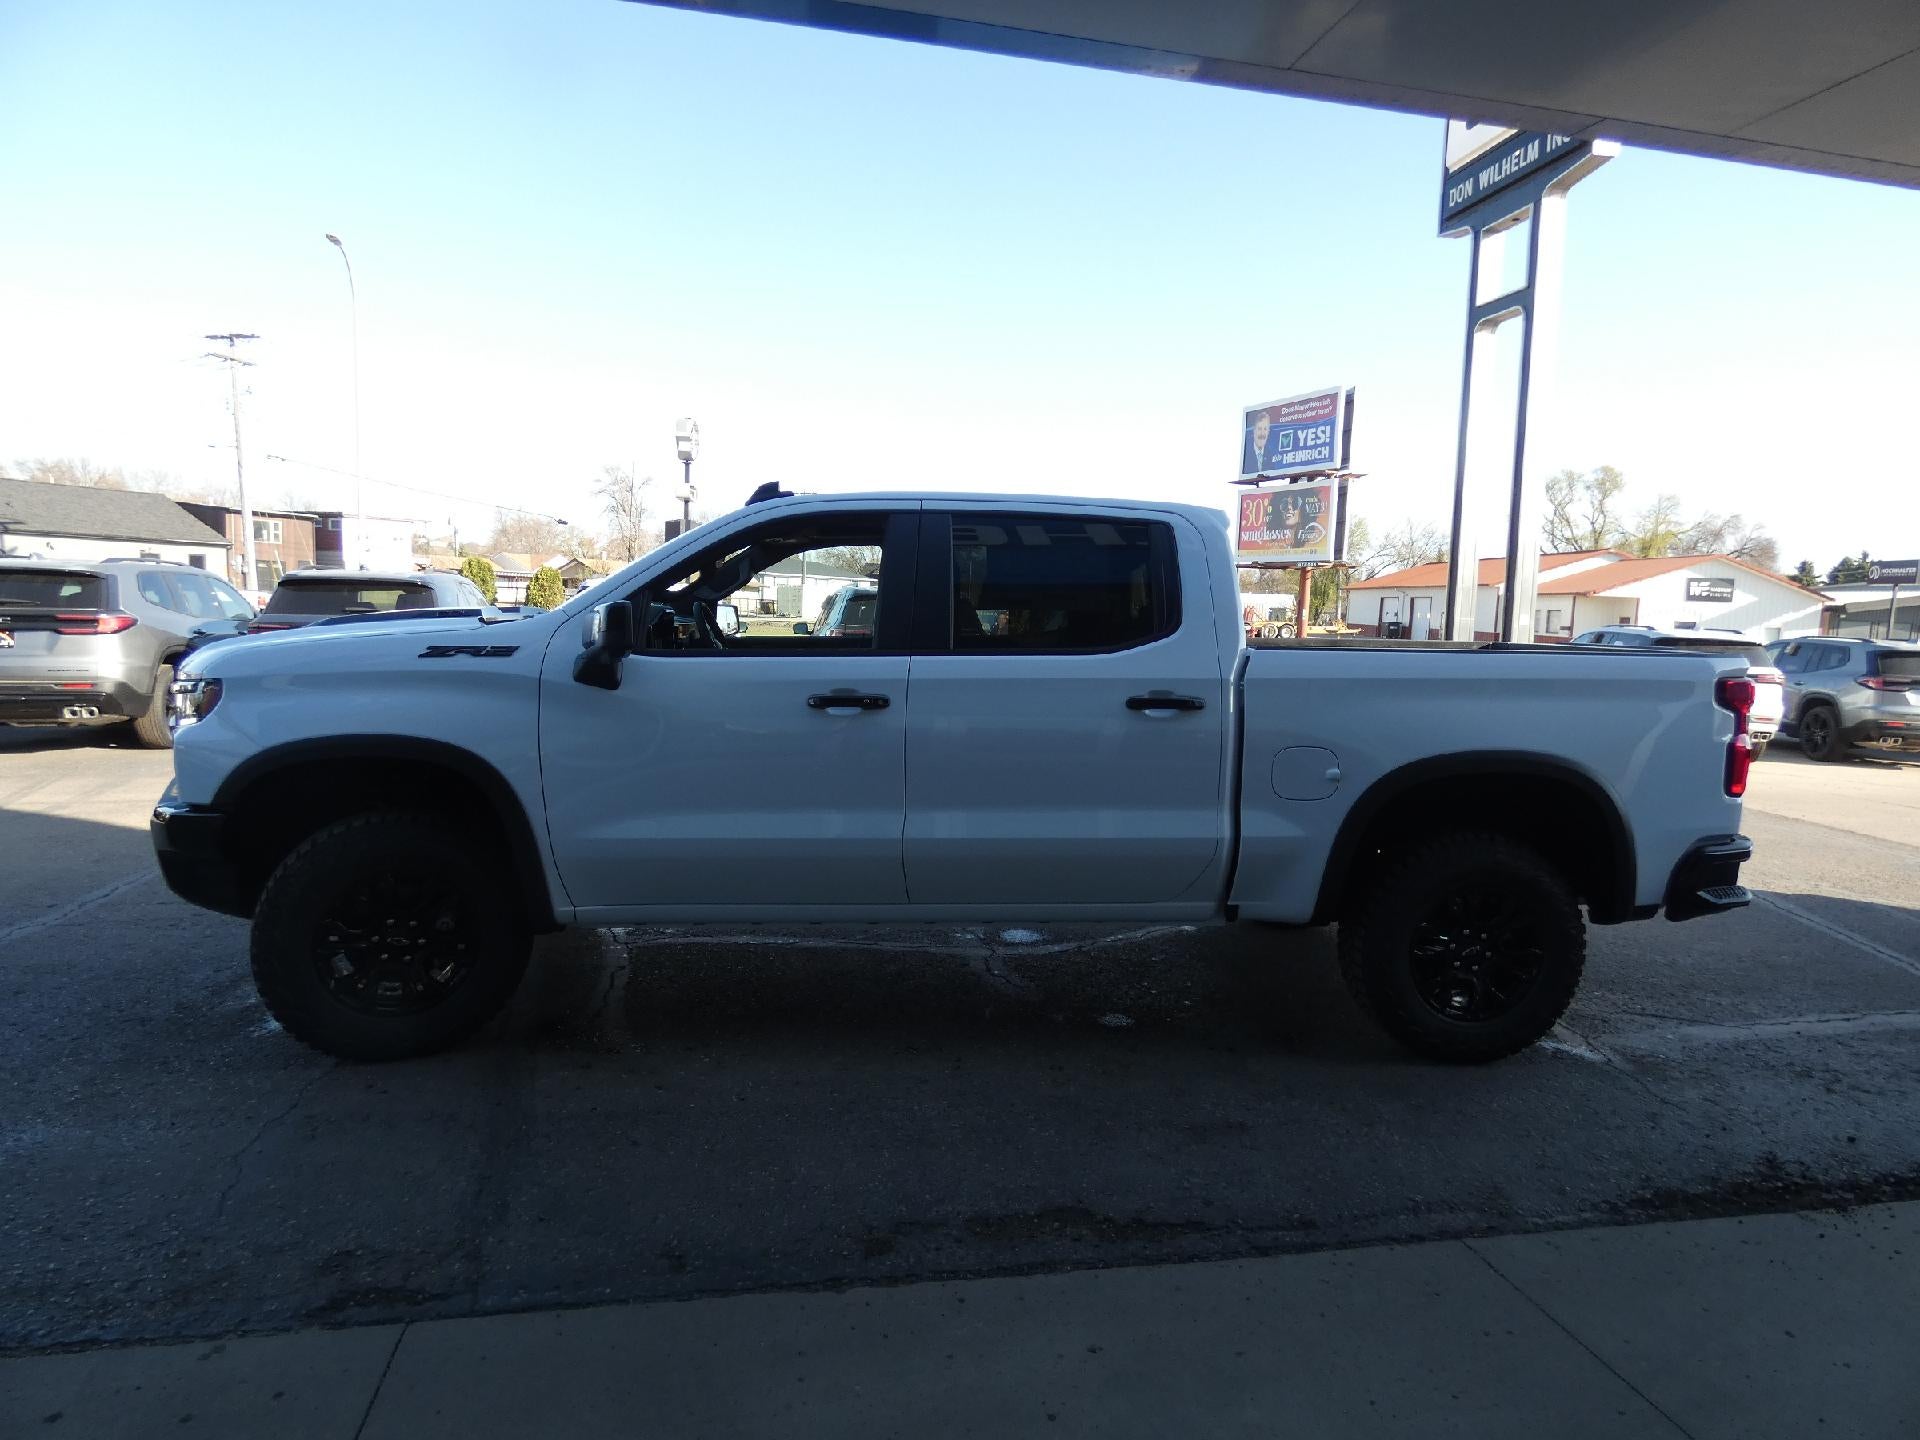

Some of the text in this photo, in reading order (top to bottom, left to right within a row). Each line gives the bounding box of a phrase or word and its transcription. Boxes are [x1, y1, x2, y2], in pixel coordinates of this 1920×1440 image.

[1449, 177, 1473, 207] DON
[1479, 138, 1540, 191] WILHELM
[1298, 425, 1331, 447] YES!
[1282, 446, 1330, 464] HEINRICH
